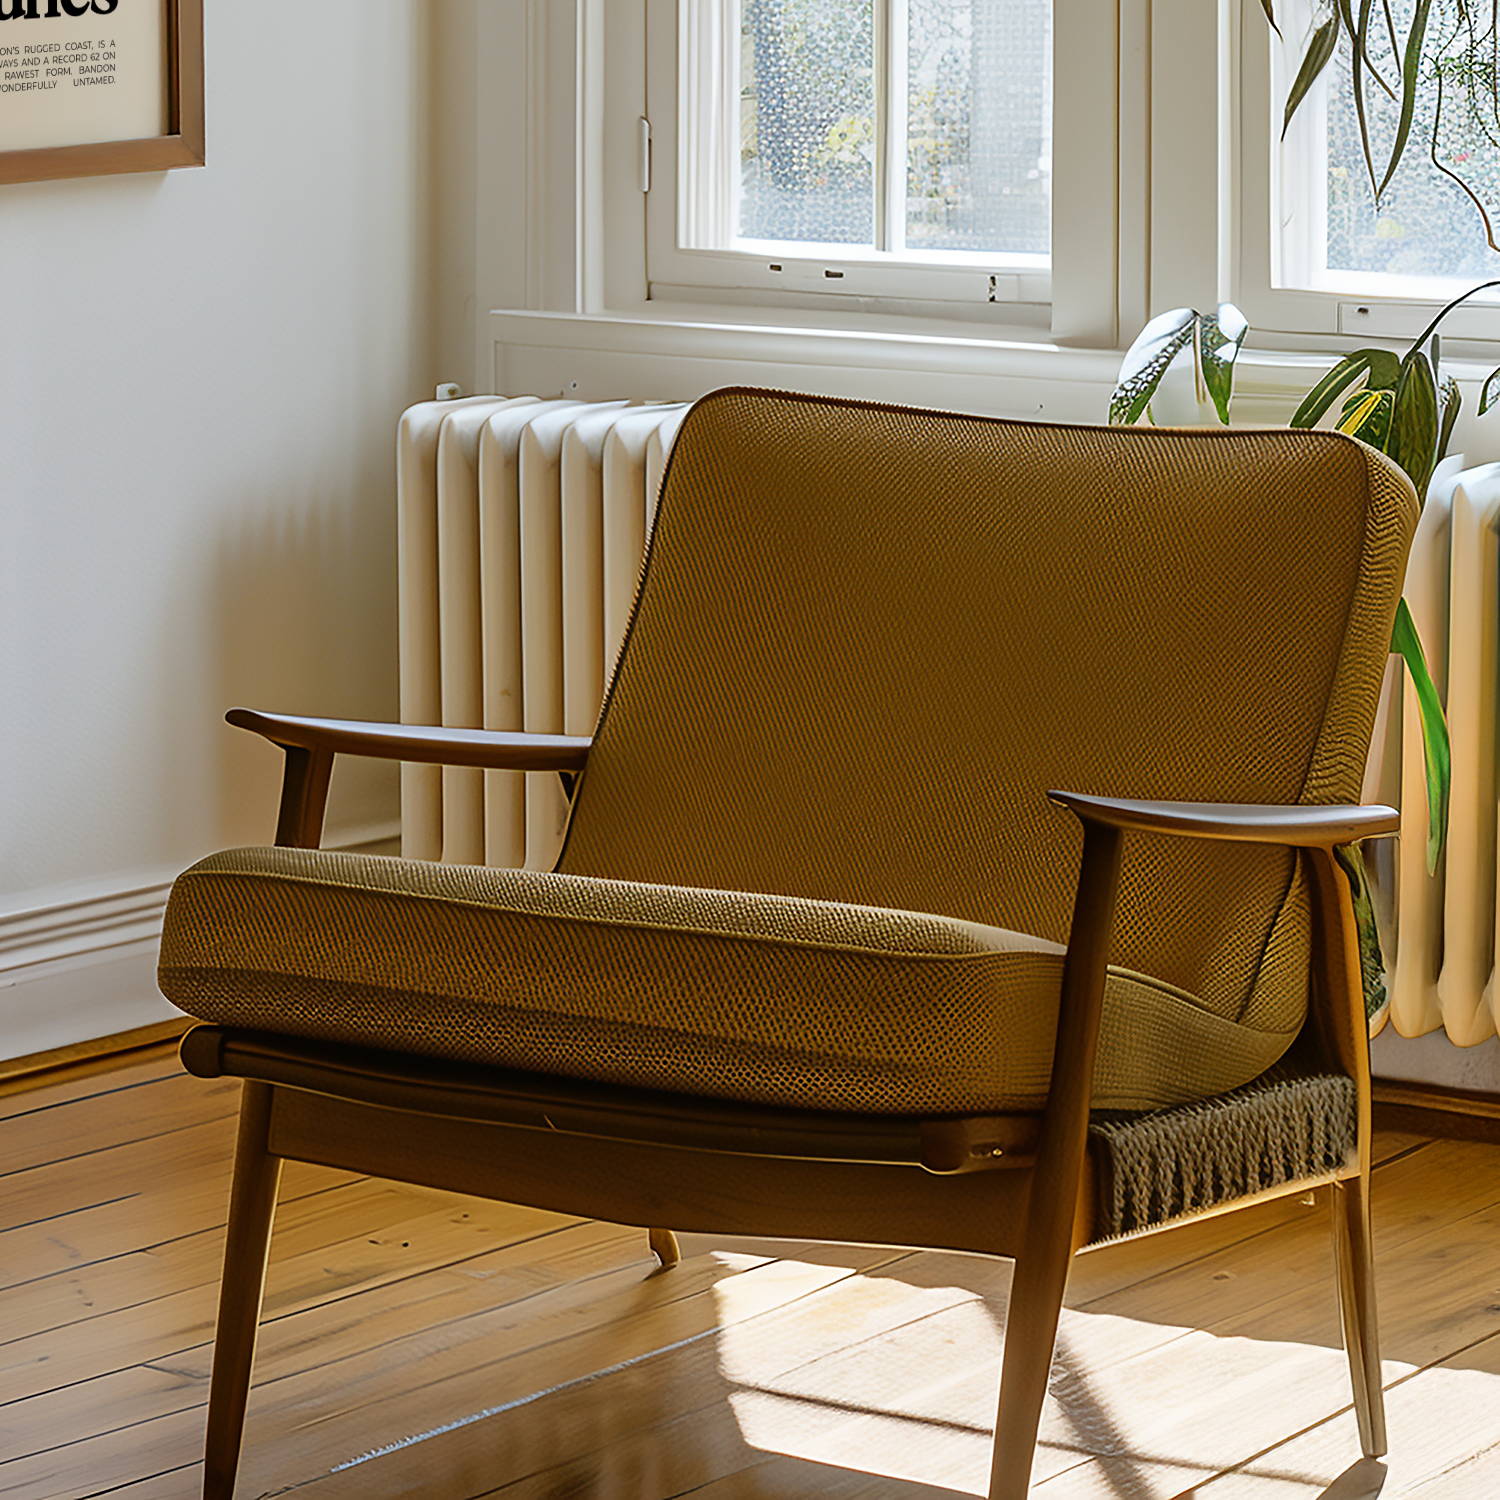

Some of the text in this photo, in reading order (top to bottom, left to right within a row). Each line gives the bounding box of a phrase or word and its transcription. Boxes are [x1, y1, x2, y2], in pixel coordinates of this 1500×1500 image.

[24, 43, 61, 54] RUGGED
[64, 40, 94, 51] COAST,
[98, 39, 106, 49] IS
[109, 39, 116, 48] A
[21, 56, 41, 67] AND
[42, 56, 50, 65] A
[52, 53, 88, 64] RECORD
[90, 52, 100, 62] 62
[102, 51, 116, 61] ON
[4, 69, 40, 81] RAWEST
[45, 66, 73, 77] FORM.
[78, 63, 116, 75] BANDON
[73, 75, 116, 87] UNTAMED.
